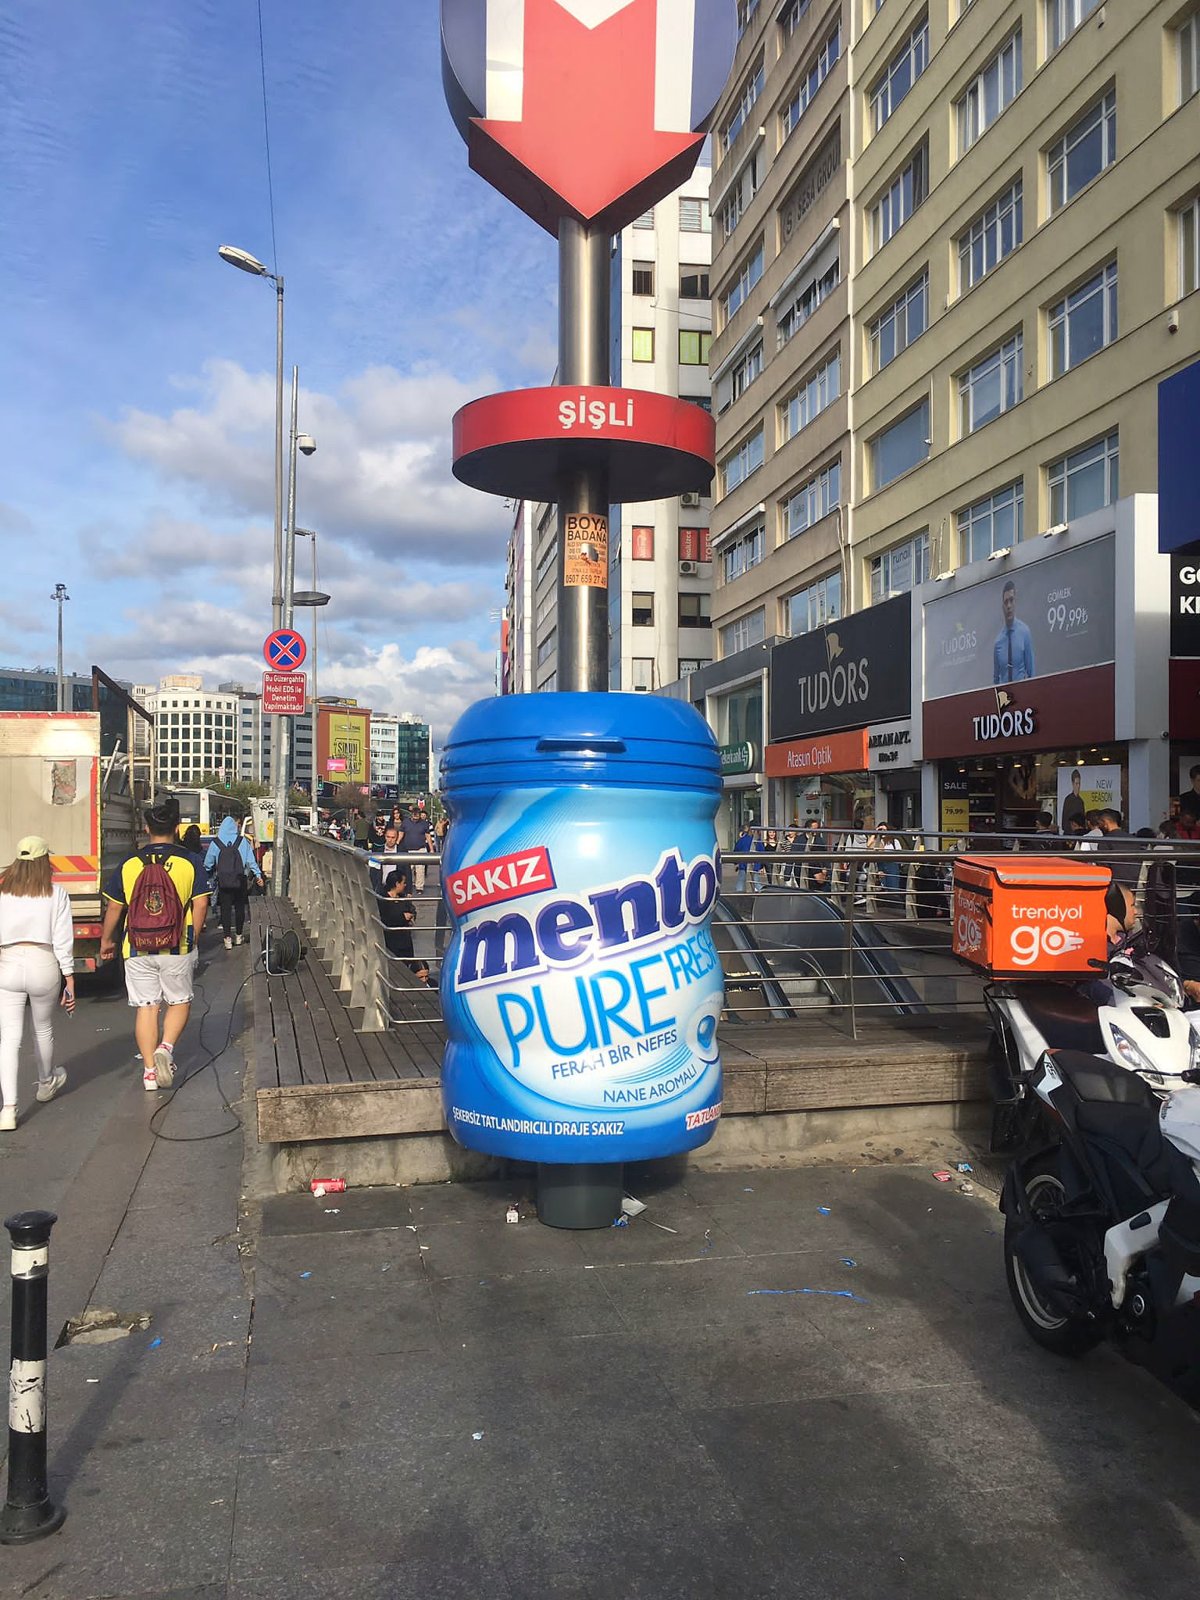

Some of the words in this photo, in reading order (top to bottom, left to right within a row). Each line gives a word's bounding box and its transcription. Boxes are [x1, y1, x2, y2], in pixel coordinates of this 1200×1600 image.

[558, 395, 634, 429] ŞİŞLİ
[568, 516, 607, 532] BOYA
[567, 530, 607, 544] BADANA
[1179, 564, 1200, 585] G
[265, 674, 273, 682] Bu
[266, 685, 282, 693] Mobil
[282, 685, 295, 693] EDS
[798, 657, 870, 715] TUDORS
[271, 694, 297, 702] Denetim
[972, 707, 1035, 741] TUDORS
[787, 750, 811, 768] Atasun
[811, 745, 832, 769] Optik
[944, 782, 968, 790] SALE
[1095, 779, 1113, 789] NEW
[452, 854, 547, 905] SAKIZ
[1011, 904, 1083, 922] trendyol
[497, 955, 677, 1068] PURE
[551, 1053, 606, 1080] FERAH
[609, 1043, 635, 1065] BİR
[636, 1029, 678, 1056] NEFES
[603, 1088, 648, 1103] NANE
[648, 1063, 698, 1100] AROMALI
[452, 1106, 481, 1127] ŞEKERSİZ
[480, 1113, 553, 1135] TATLANDIRICILI
[553, 1120, 591, 1136] DRAJE
[591, 1121, 625, 1136] SAKIZ
